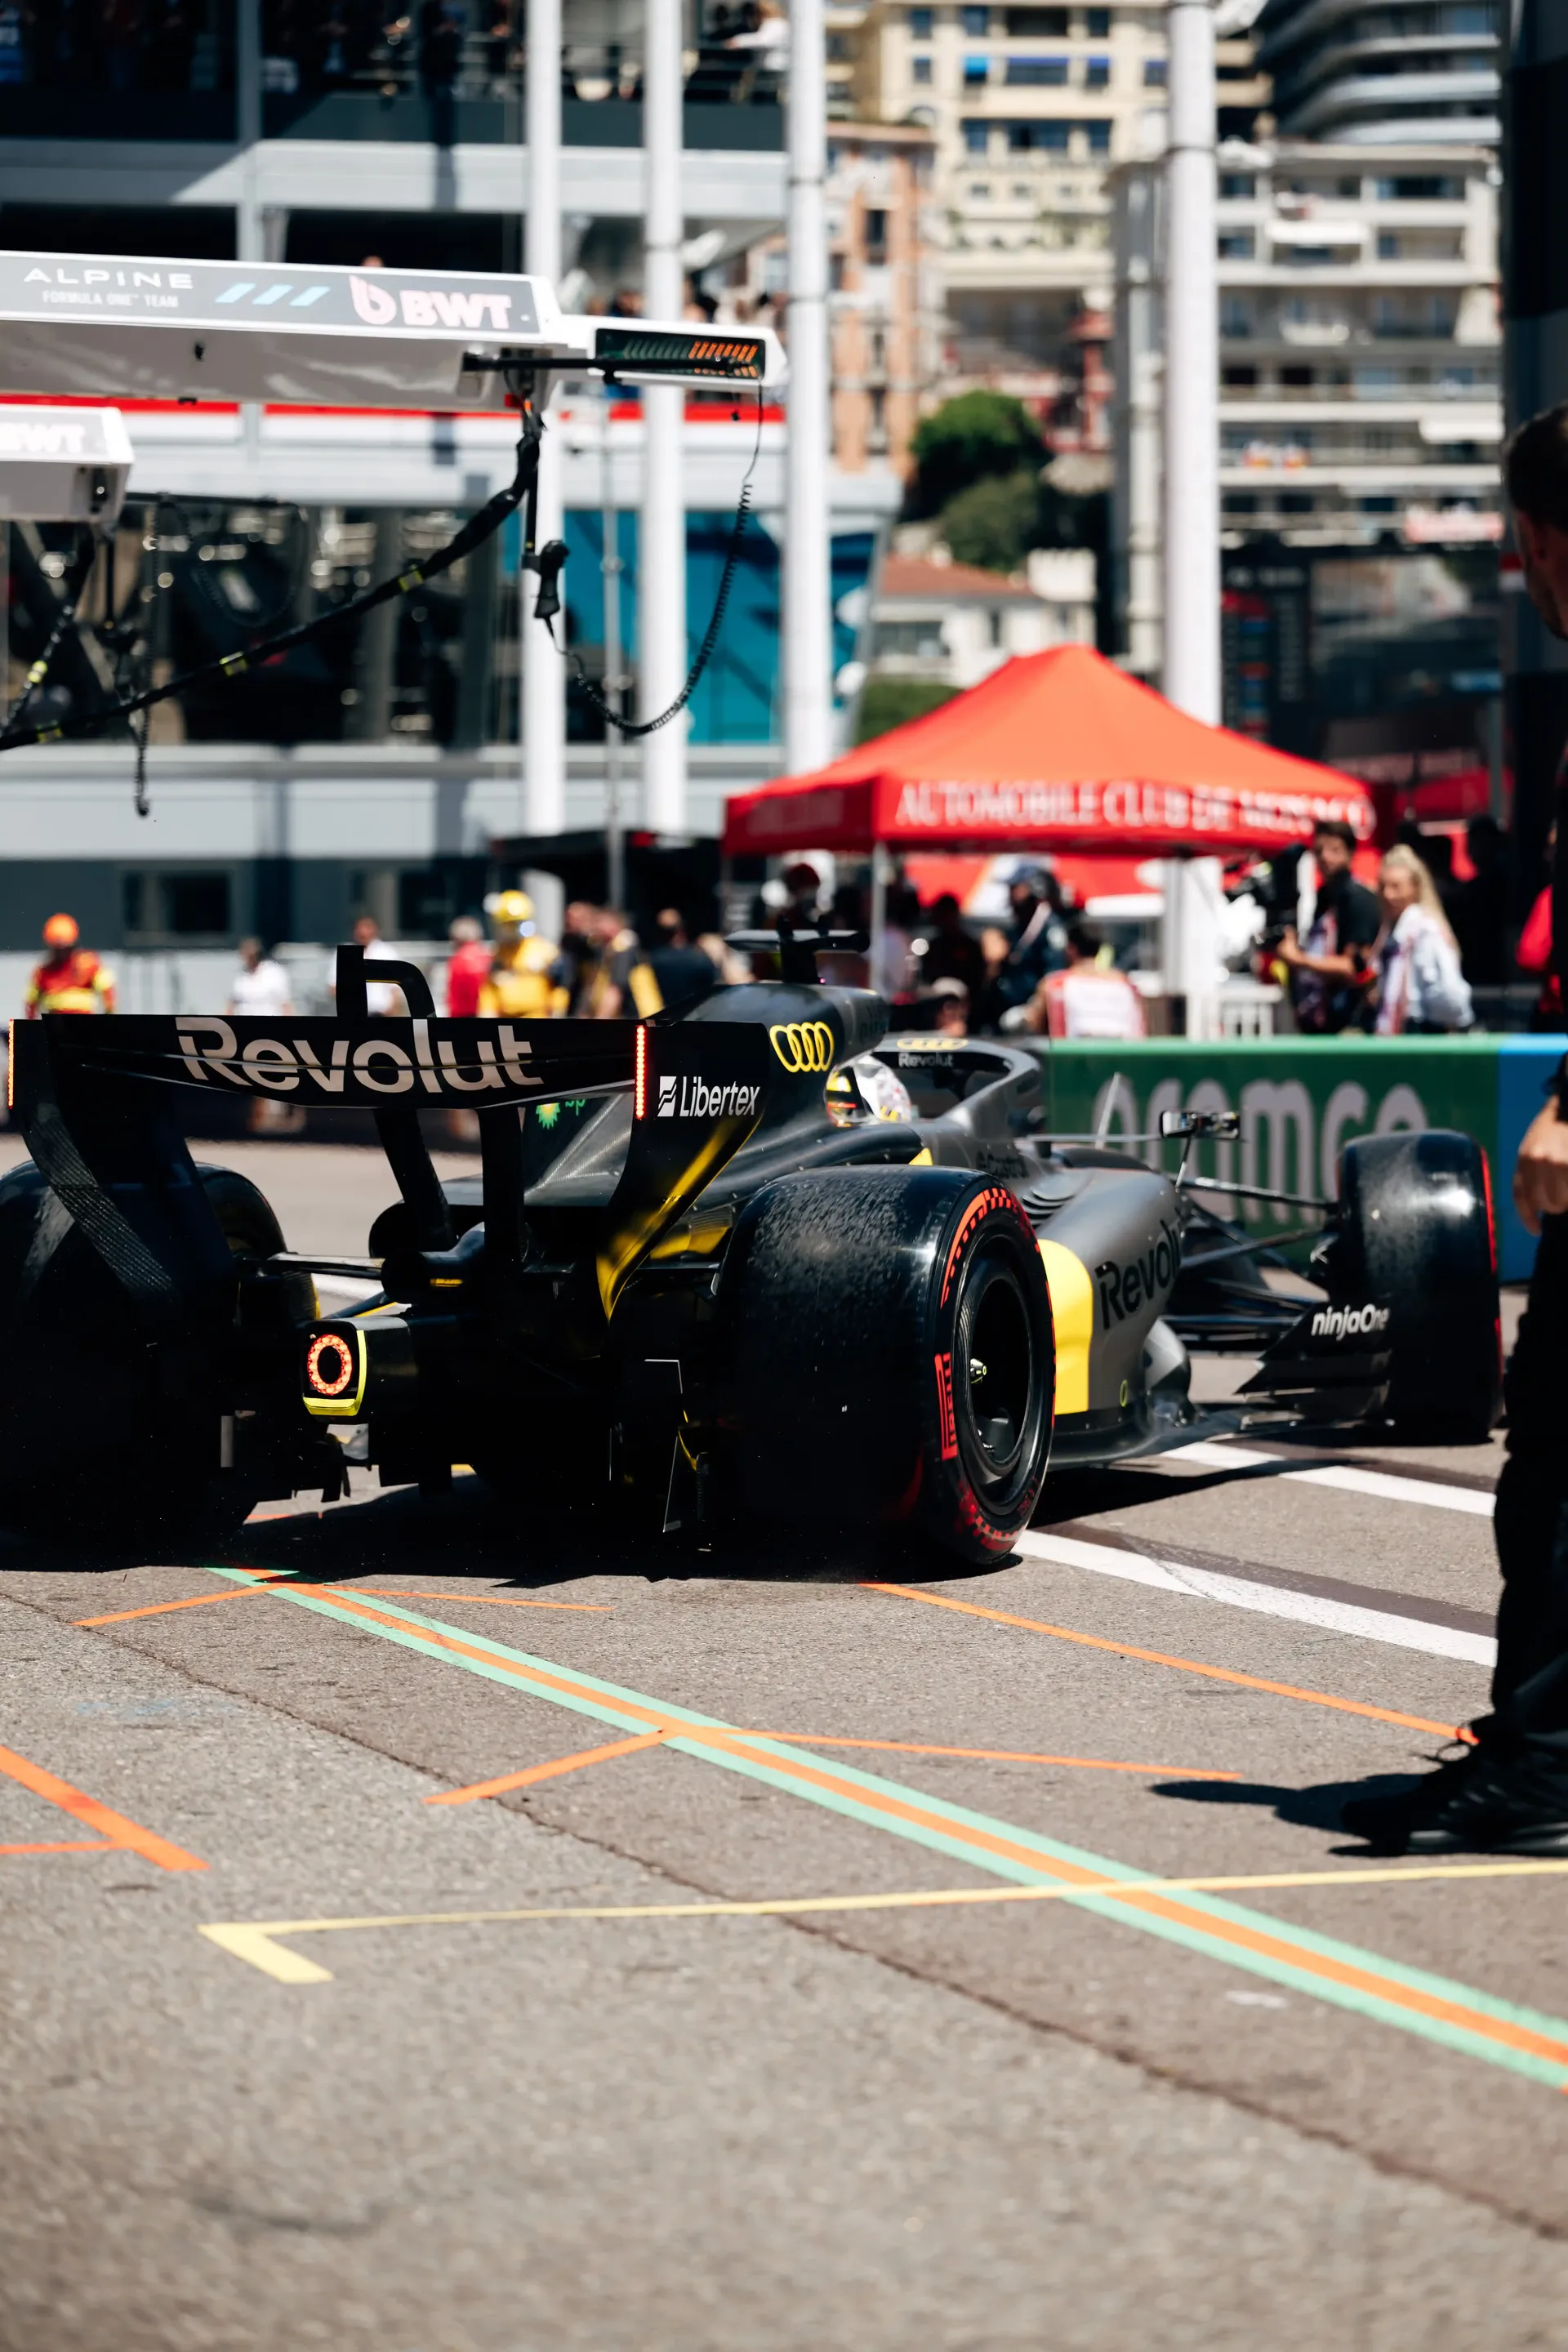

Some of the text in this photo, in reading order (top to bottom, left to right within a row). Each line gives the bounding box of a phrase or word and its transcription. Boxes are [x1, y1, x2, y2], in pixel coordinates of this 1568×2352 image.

[24, 268, 194, 290] ALPINE
[42, 290, 103, 305] FORMULA
[144, 295, 179, 309] TEAM
[400, 290, 512, 328] BWT
[895, 780, 1099, 827] AUTOMOBILE
[1102, 781, 1189, 828] CLUB
[1192, 784, 1232, 831] DE
[175, 1017, 545, 1094] Revolut
[898, 1052, 954, 1067] Revolut
[679, 1076, 760, 1117] Libertex
[1311, 1303, 1389, 1341] ninjaOne
[935, 1352, 958, 1461] PIRELLI
